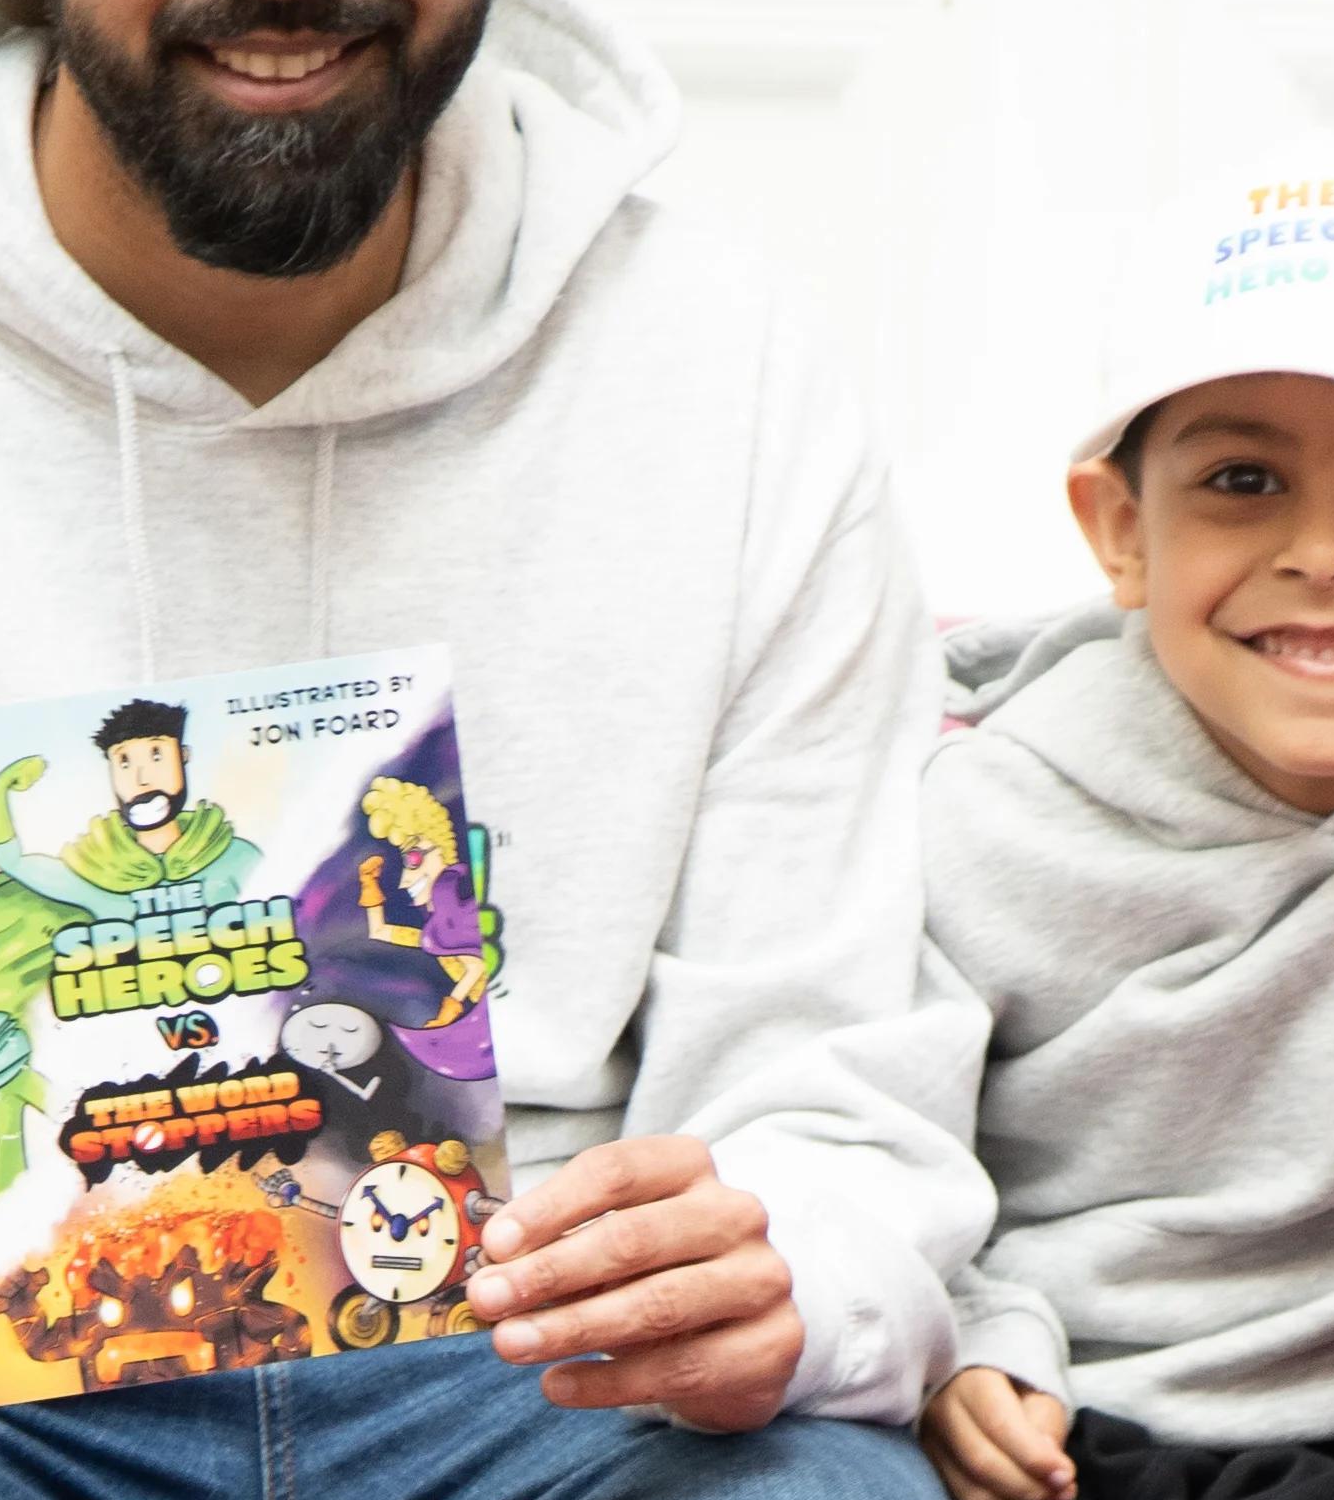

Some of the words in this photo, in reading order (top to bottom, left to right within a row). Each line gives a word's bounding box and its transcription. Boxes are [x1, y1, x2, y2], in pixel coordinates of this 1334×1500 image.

[226, 678, 381, 715] ILLUSTRATED
[388, 674, 416, 693] BY
[250, 722, 302, 747] JON
[312, 708, 401, 737] FOARD
[130, 879, 205, 916] THE
[52, 896, 297, 974] SPEECH
[51, 939, 311, 1021] HEROES
[83, 1088, 176, 1128] THE
[175, 1071, 302, 1114] WORD
[68, 1098, 323, 1164] STOPPERS
